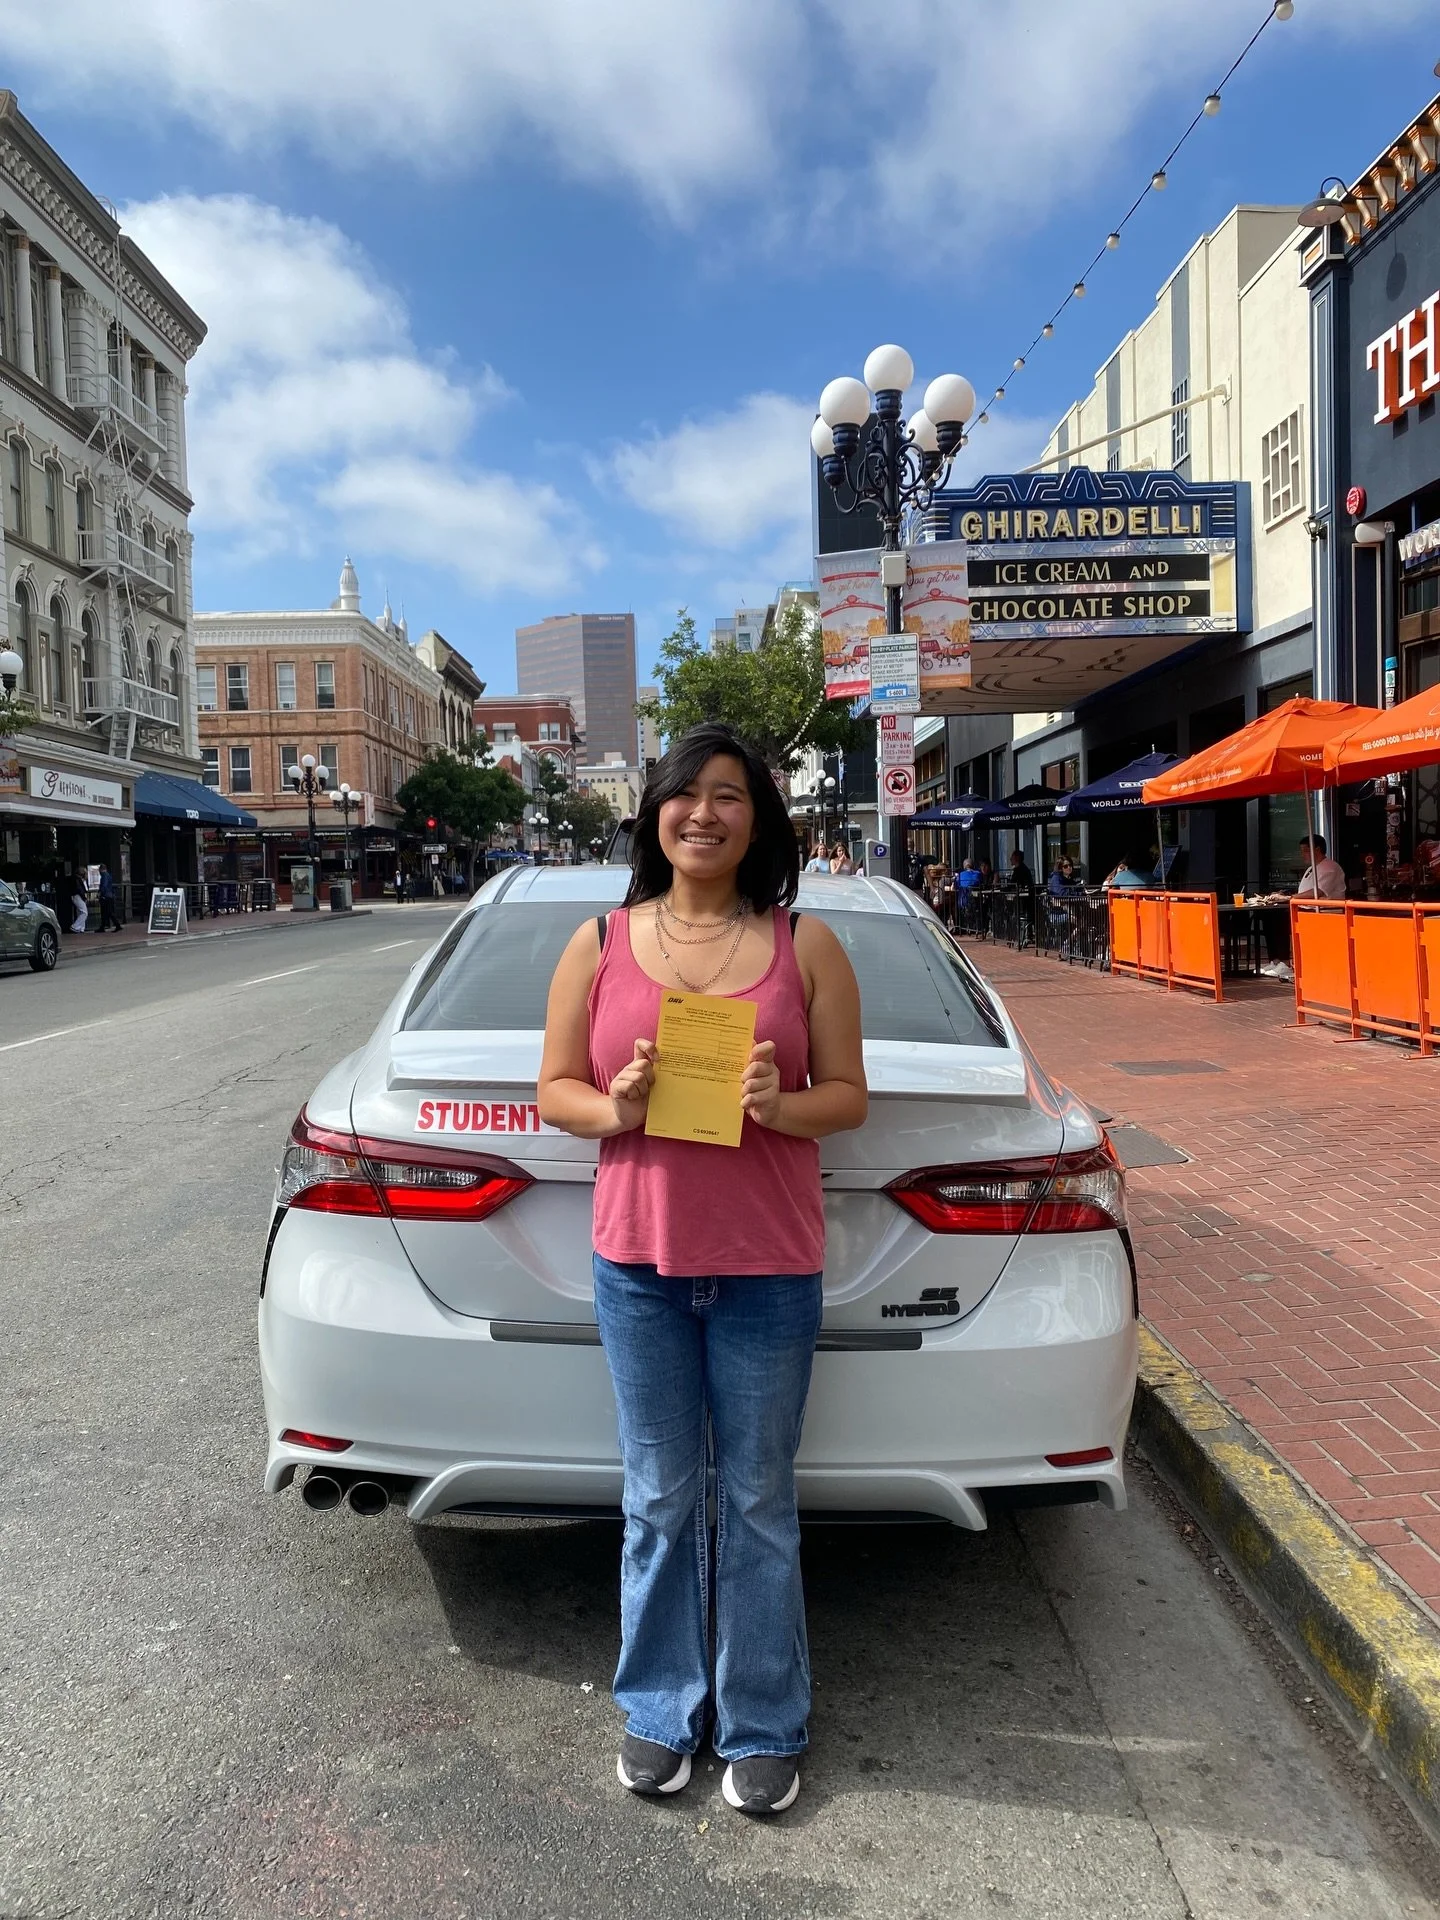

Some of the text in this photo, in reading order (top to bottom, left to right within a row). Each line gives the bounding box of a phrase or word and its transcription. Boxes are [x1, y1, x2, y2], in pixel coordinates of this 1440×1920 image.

[1366, 290, 1440, 425] TH
[960, 504, 1201, 540] GHIRARDELLI
[995, 561, 1169, 584] ICE CREAM AND
[969, 594, 1191, 622] CHOCOLATE SHOP
[871, 645, 898, 653] PAY-BY-PLATE
[883, 716, 895, 729] NO
[883, 731, 912, 742] PARKING
[1299, 752, 1322, 762] HOME
[893, 803, 905, 811] ZONE
[1091, 799, 1121, 808] WORLD
[989, 814, 1011, 822] WORLD
[1012, 812, 1036, 820] FAMOUS
[667, 996, 684, 1004] DMV
[418, 1101, 540, 1133] STUDENT
[919, 1286, 959, 1302] SE
[881, 1302, 947, 1318] HYBRID
